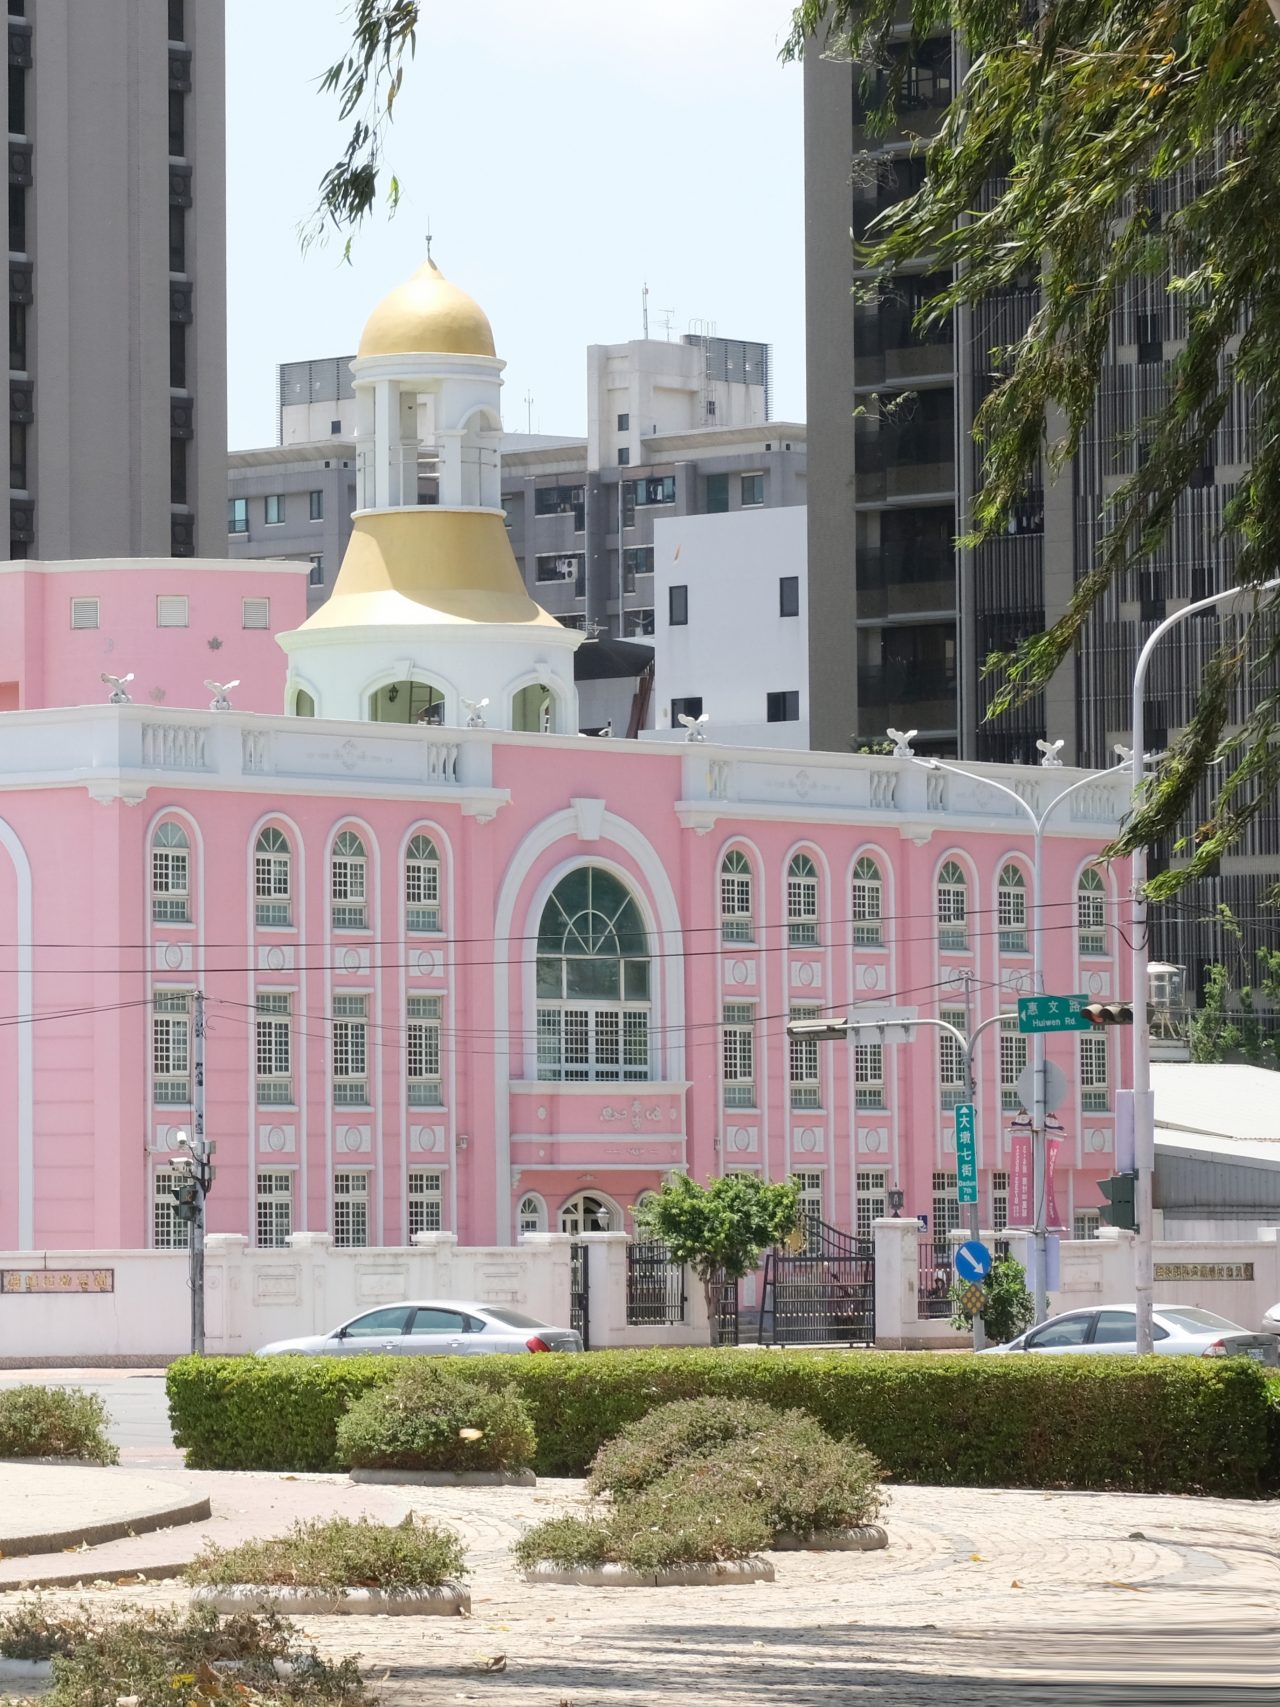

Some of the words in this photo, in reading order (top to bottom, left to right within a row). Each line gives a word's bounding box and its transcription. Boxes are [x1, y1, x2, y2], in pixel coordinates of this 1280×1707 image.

[1026, 1000, 1080, 1016] 惠文路
[1032, 1018, 1061, 1027] Huiwen
[959, 1115, 973, 1177] 大墩七街
